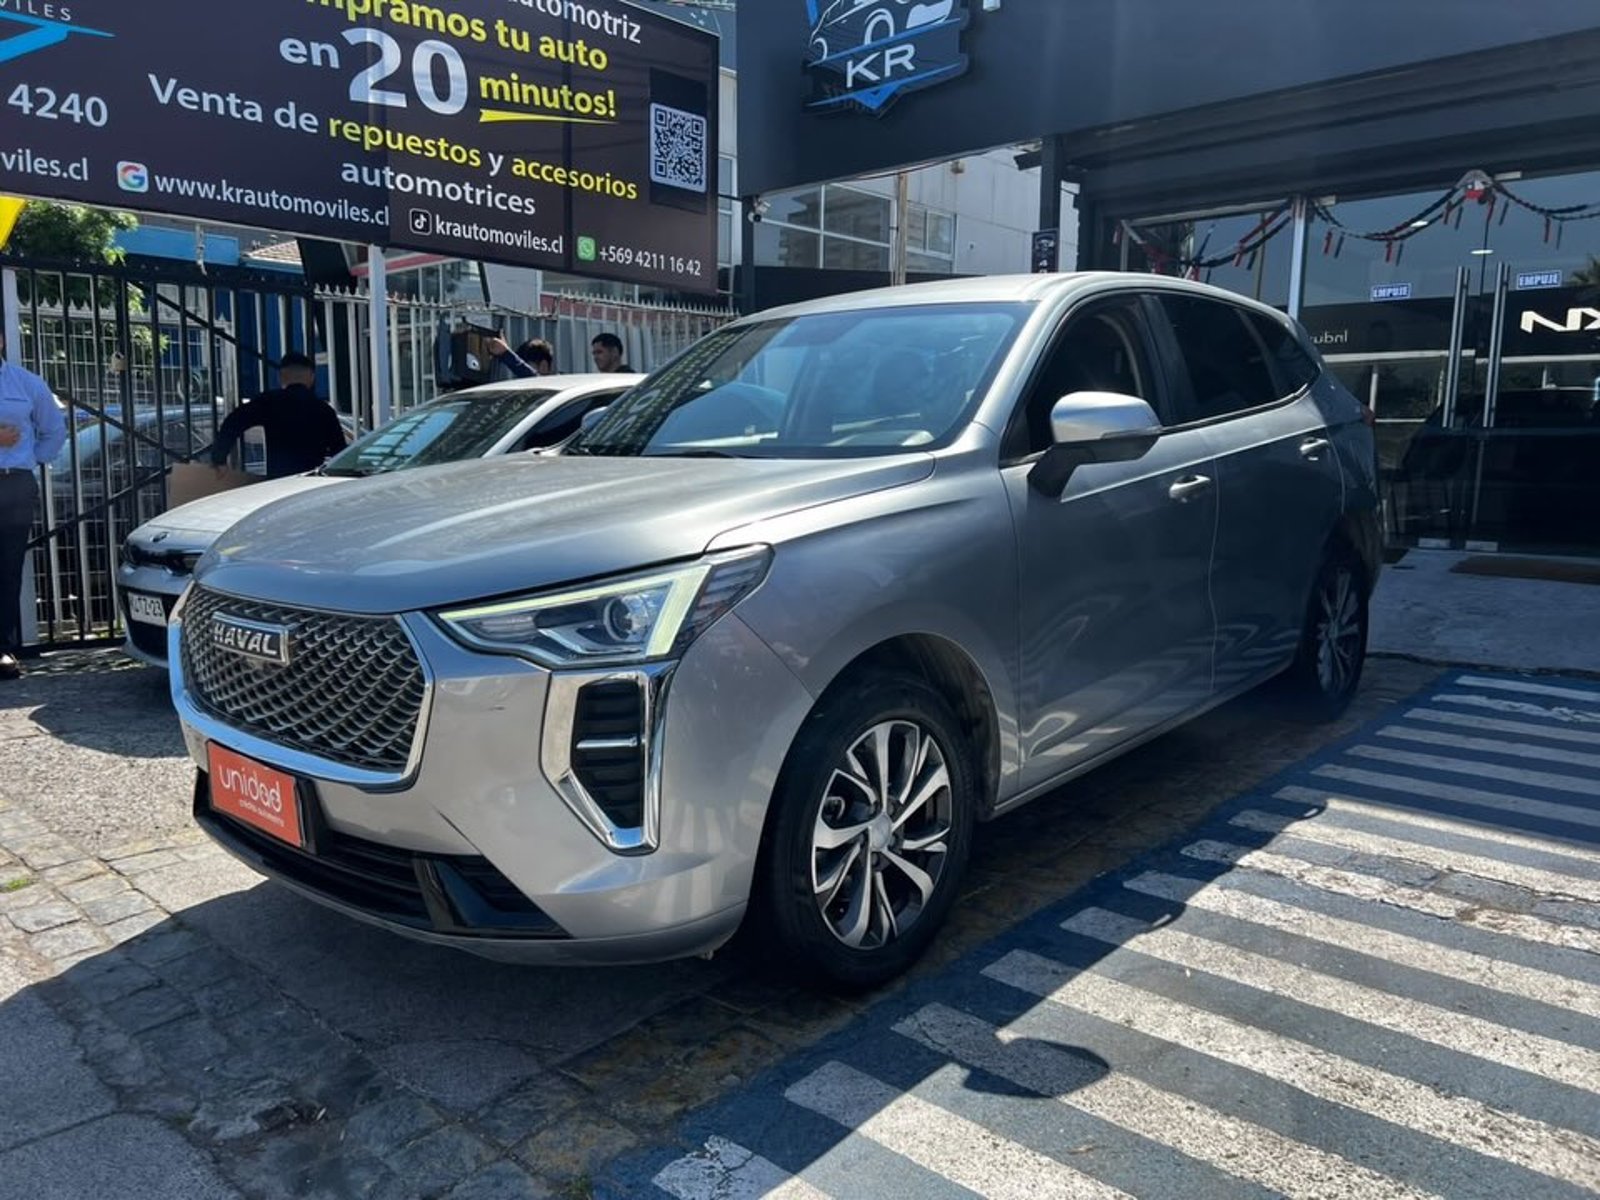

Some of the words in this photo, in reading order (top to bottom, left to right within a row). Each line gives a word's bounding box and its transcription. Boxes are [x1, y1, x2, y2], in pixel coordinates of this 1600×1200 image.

[494, 19, 530, 52] tu
[539, 36, 608, 70] auto
[846, 44, 916, 88] KR
[279, 37, 340, 69] en
[341, 27, 468, 115] 20
[479, 72, 616, 118] minutos!
[7, 83, 109, 127] 4240
[148, 73, 263, 122] Venta
[274, 102, 319, 133] de
[329, 118, 481, 167] repuestos
[487, 152, 504, 177] y
[512, 157, 638, 200] accesorios
[154, 174, 390, 226] www.krautomoviles.cl
[341, 162, 536, 215] automotrices
[436, 214, 563, 254] krautomoviles.cl
[600, 246, 632, 264] +569
[635, 251, 664, 270] 4211
[671, 255, 684, 273] 16
[686, 259, 701, 276] 42
[213, 622, 277, 655] HAVAL
[219, 764, 282, 813] unidad
